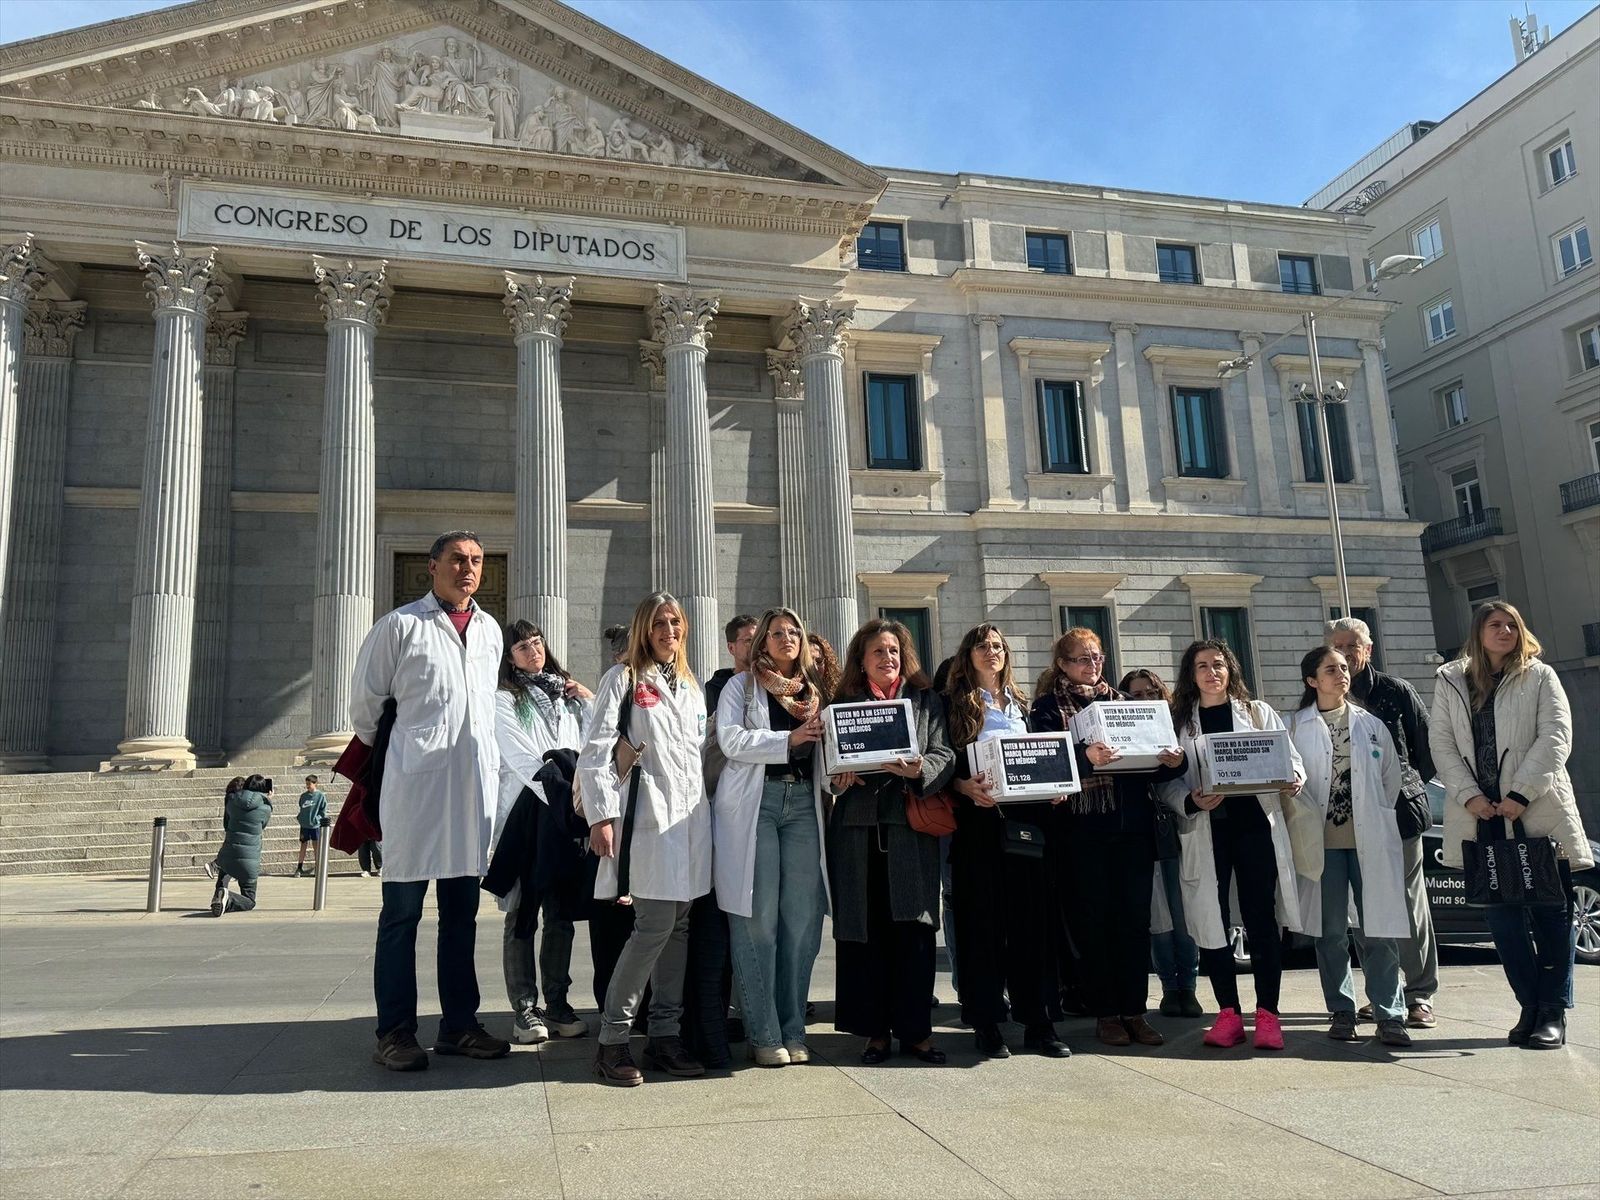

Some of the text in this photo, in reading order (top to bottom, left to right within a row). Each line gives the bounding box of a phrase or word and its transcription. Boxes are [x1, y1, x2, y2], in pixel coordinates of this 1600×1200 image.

[214, 203, 657, 262] CONGRESO DE LOS DIPUTADOS
[849, 724, 871, 733] MÉDICOS
[1485, 846, 1498, 890] Chloé Chloé
[1518, 843, 1534, 889] Chloé Chloé
[1425, 877, 1465, 889] Muchos
[1432, 896, 1452, 904] una
